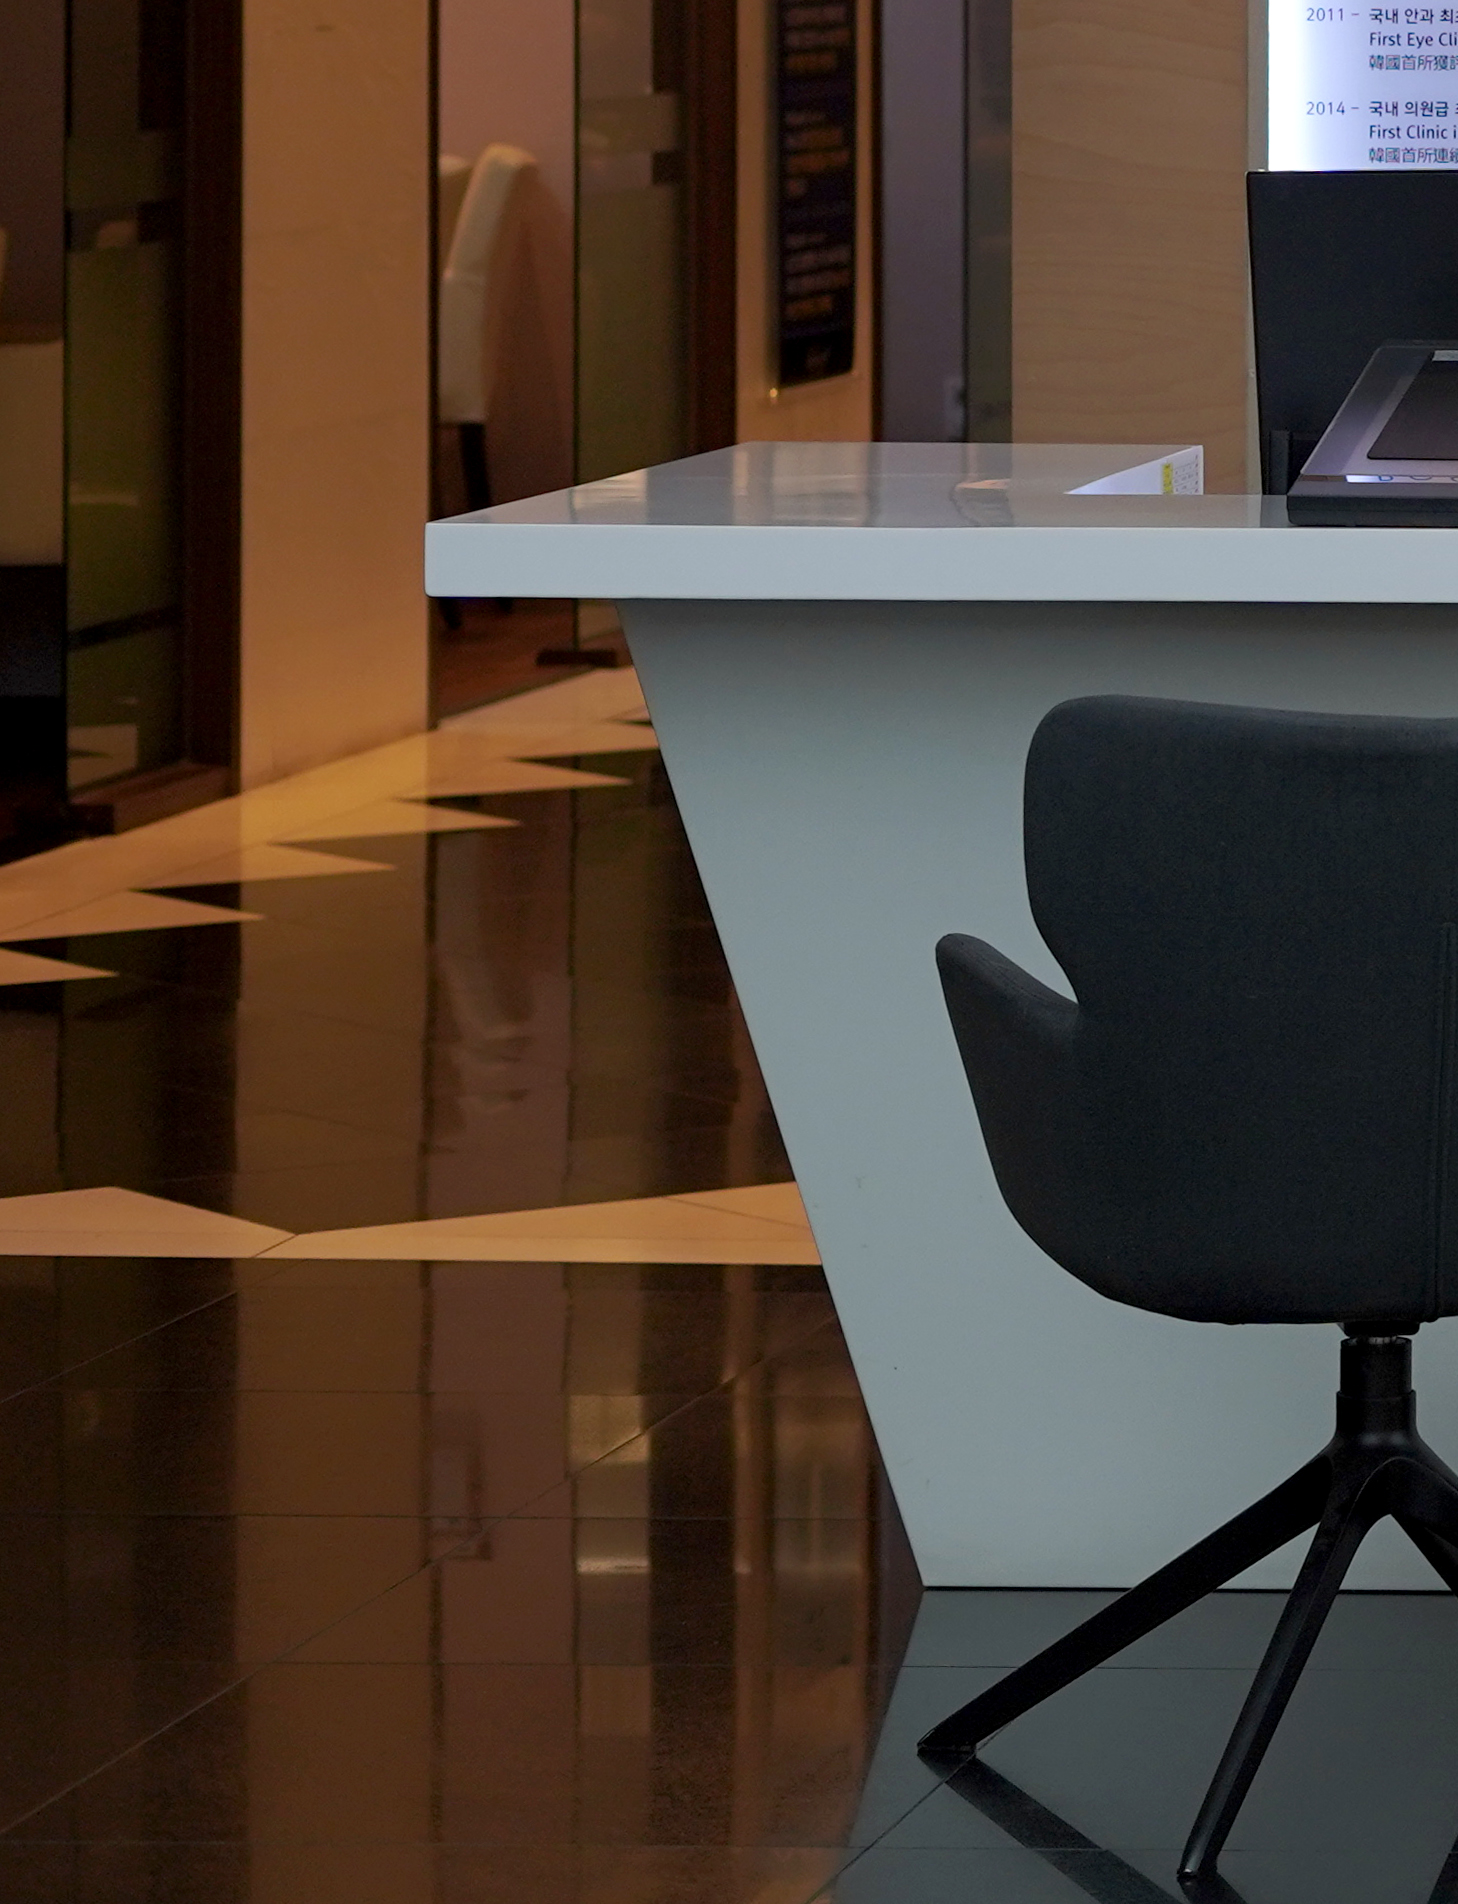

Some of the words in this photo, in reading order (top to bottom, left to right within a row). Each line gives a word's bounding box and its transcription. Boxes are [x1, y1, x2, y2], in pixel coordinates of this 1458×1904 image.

[1306, 7, 1345, 22] 2011
[1369, 8, 1399, 25] 국내
[1404, 8, 1435, 25] 안과
[1369, 31, 1402, 47] First
[1407, 31, 1434, 49] Eye
[1306, 101, 1345, 115] 2014
[1368, 100, 1399, 117] 국내
[1404, 100, 1450, 118] 의원급
[1369, 124, 1402, 140] First
[1406, 124, 1448, 140] Clinic
